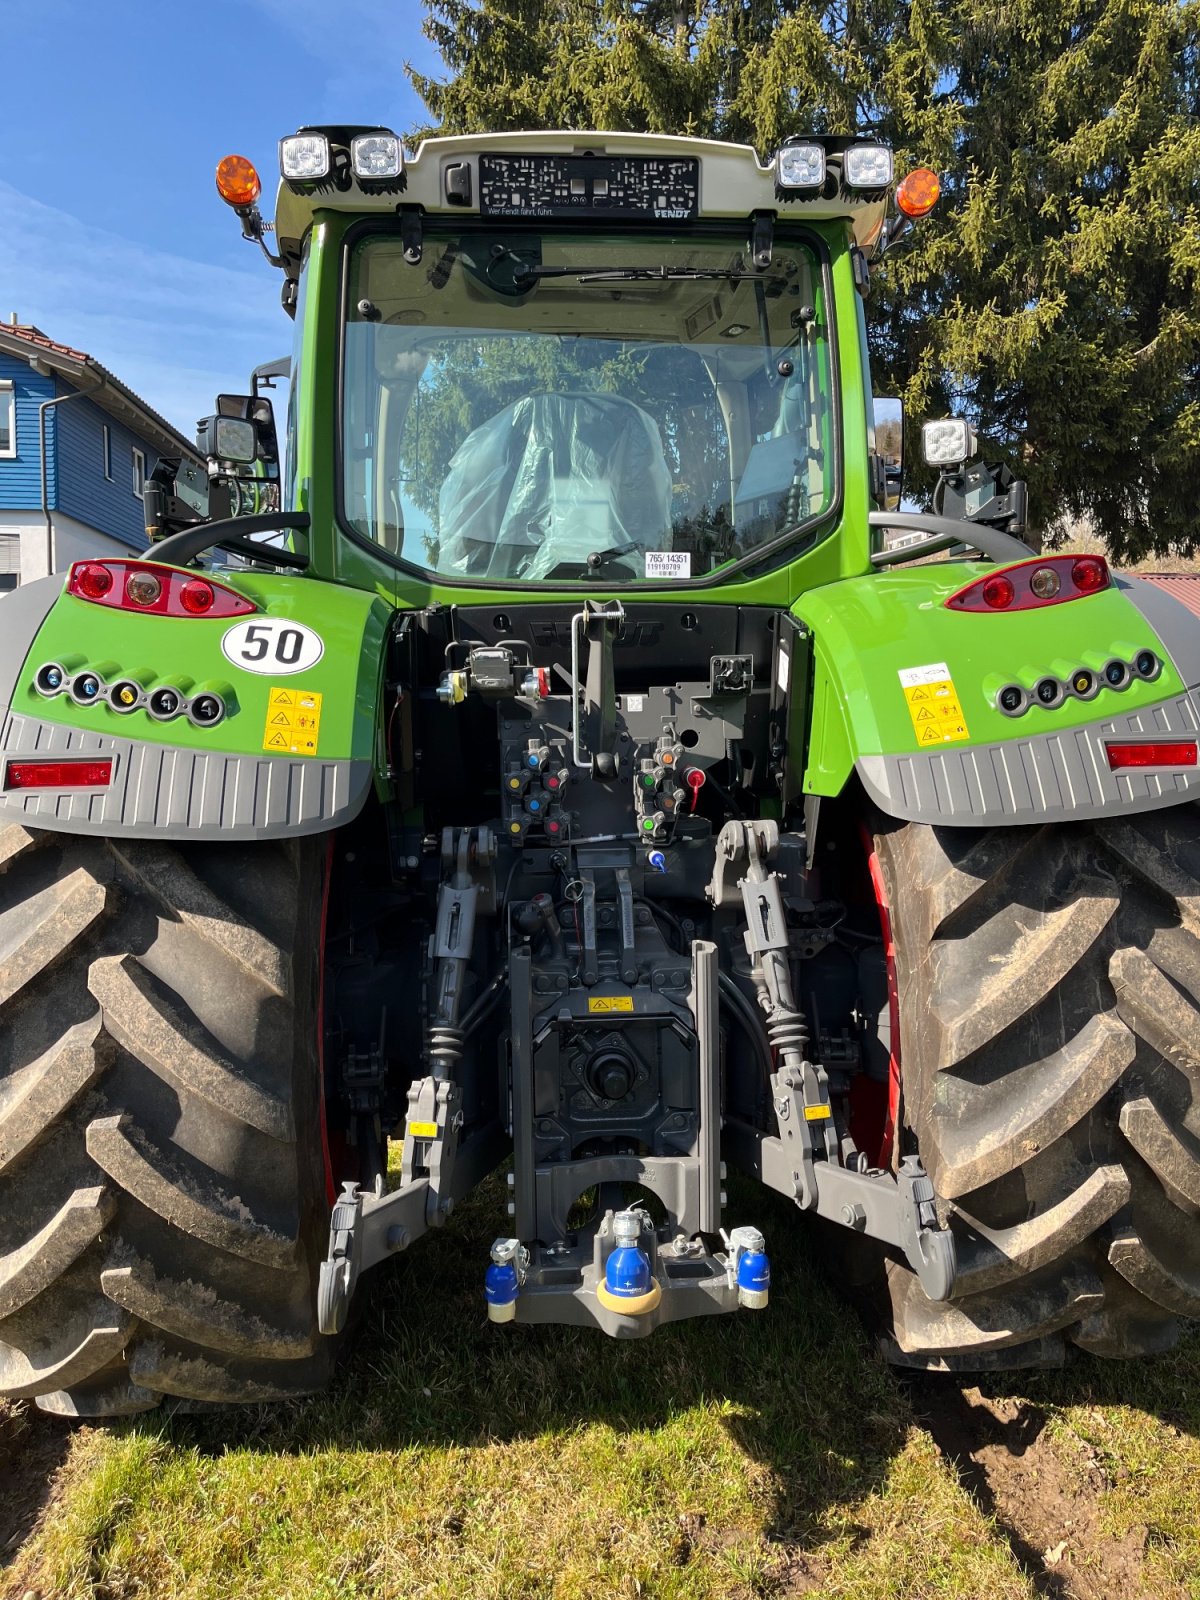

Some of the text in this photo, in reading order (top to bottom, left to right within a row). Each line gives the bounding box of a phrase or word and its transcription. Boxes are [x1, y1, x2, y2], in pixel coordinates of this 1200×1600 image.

[501, 207, 519, 215] Fendt
[654, 209, 691, 219] FENDT
[241, 625, 305, 665] 50
